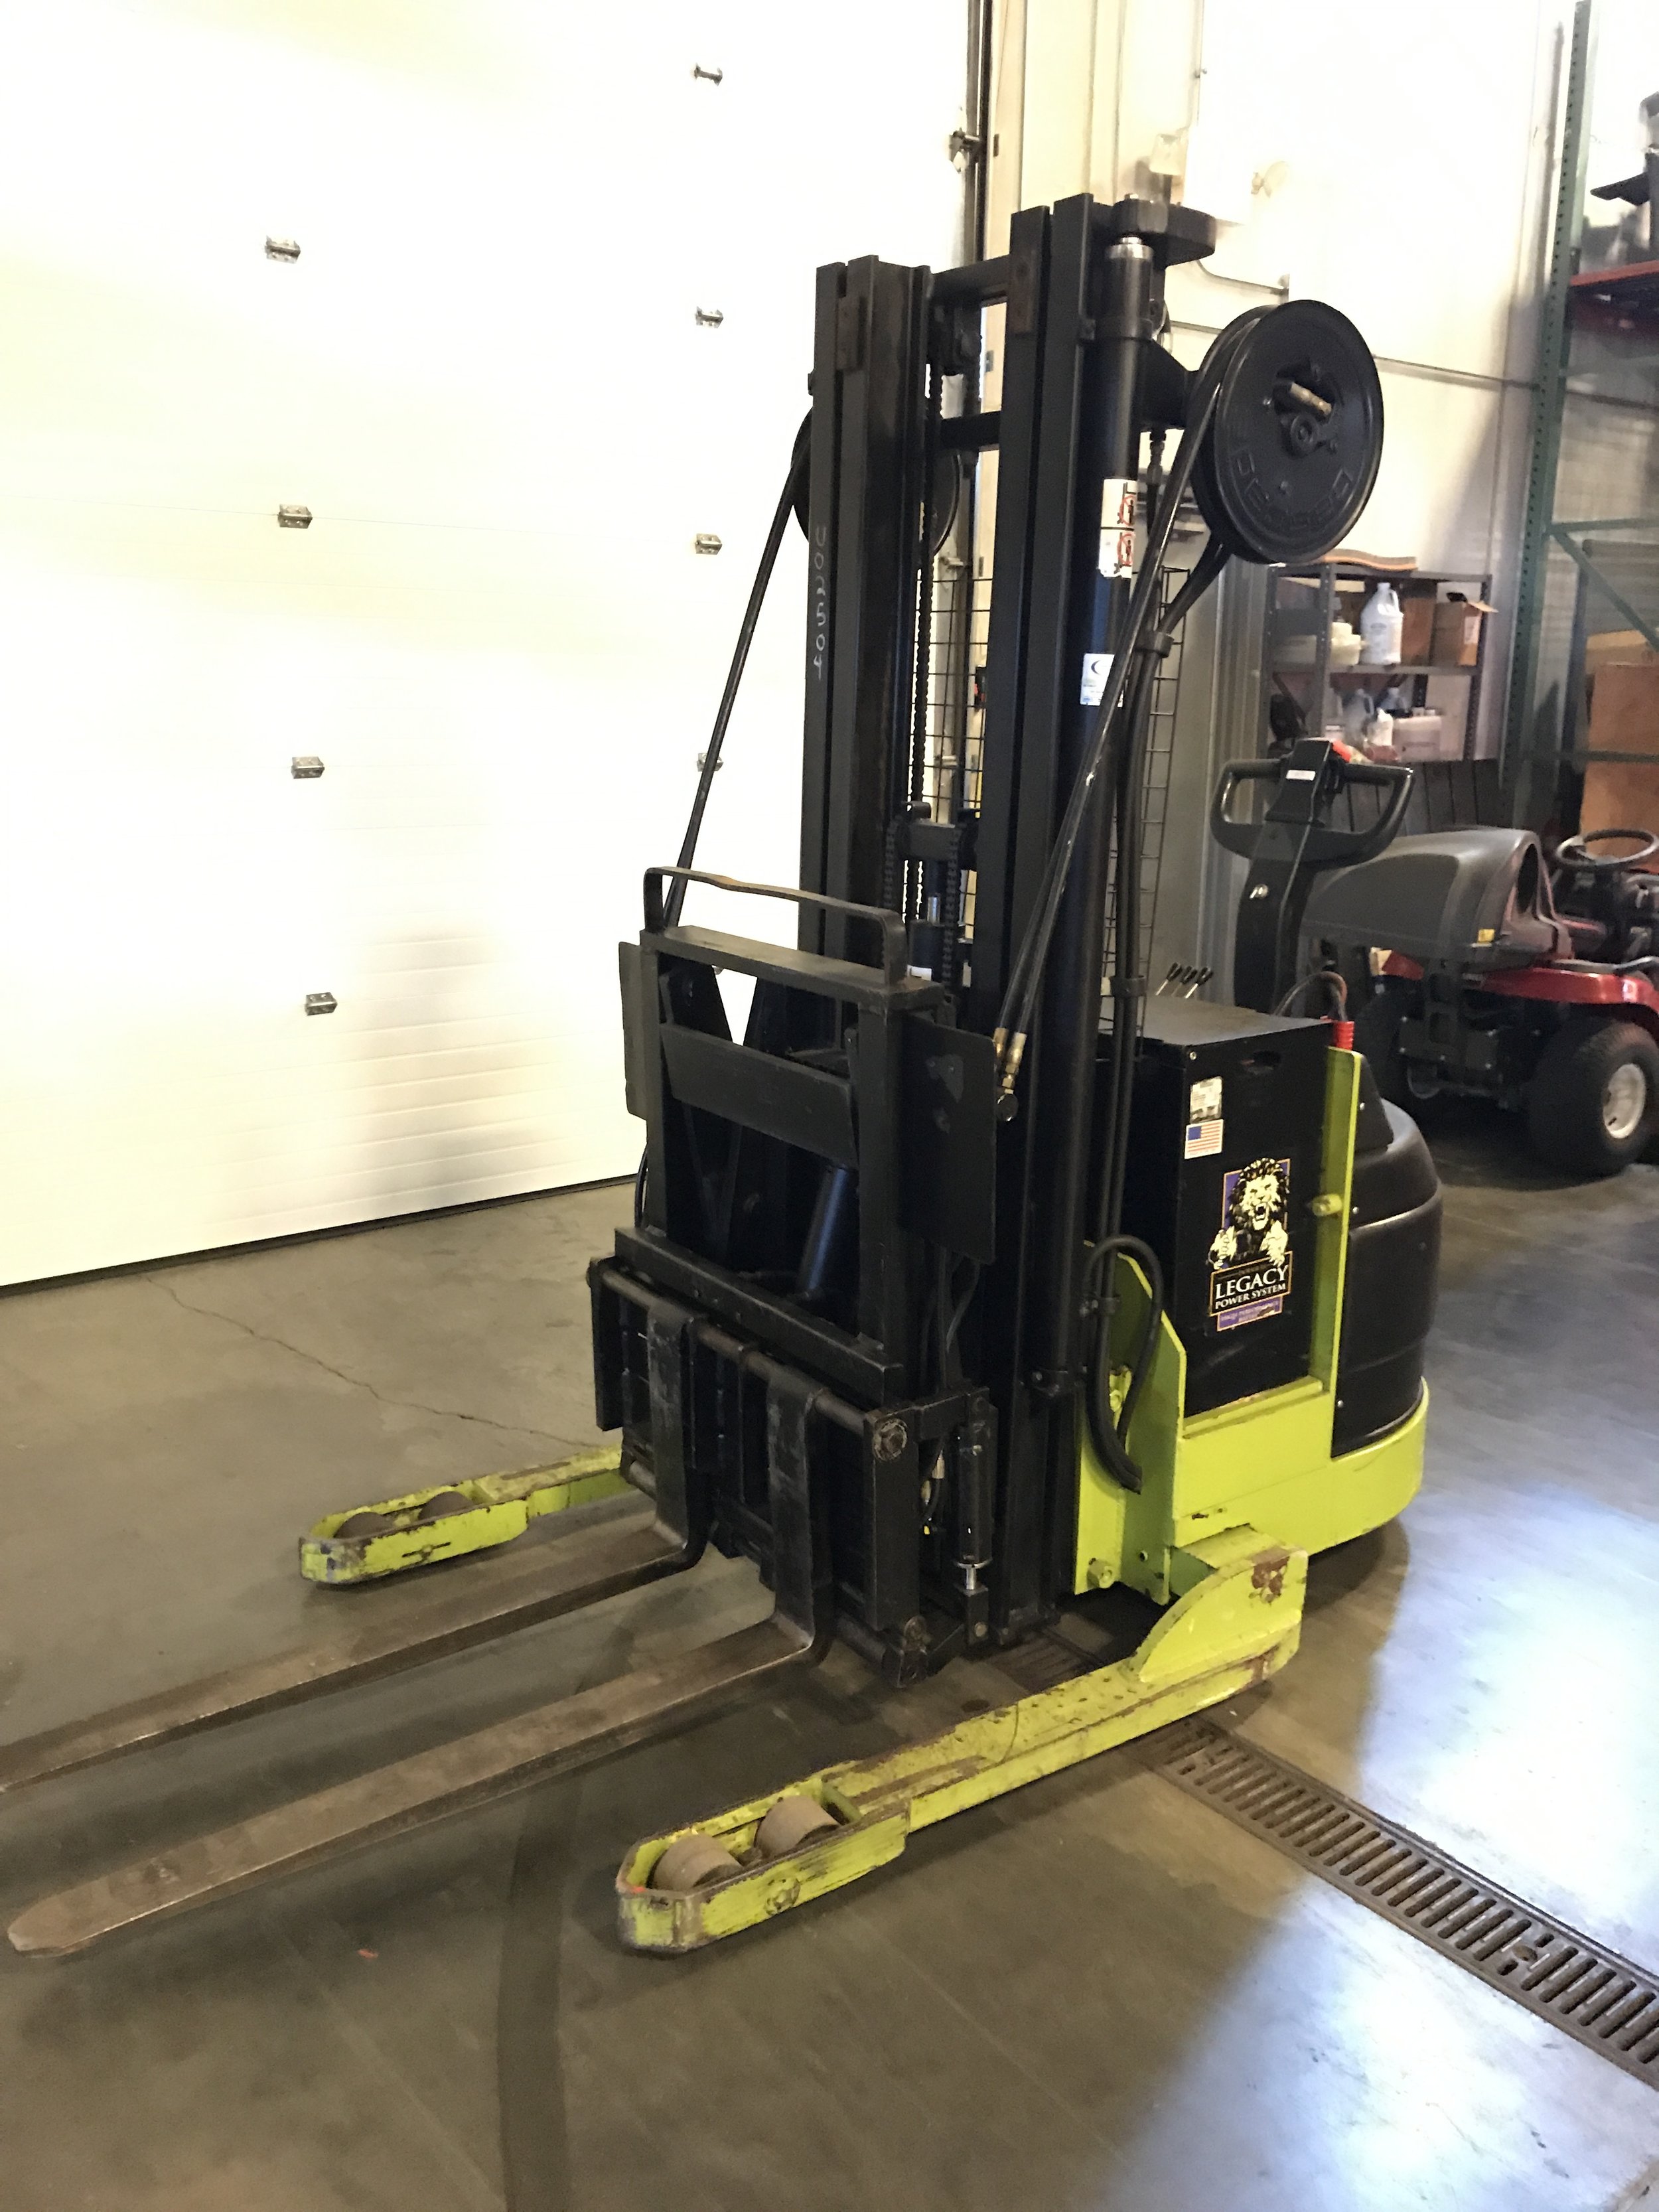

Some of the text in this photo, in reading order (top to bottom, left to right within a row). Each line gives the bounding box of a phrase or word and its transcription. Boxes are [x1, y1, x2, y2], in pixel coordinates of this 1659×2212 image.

[1215, 1283, 1286, 1309] POWER SYSTEM
[1216, 1264, 1289, 1299] LEGACY
